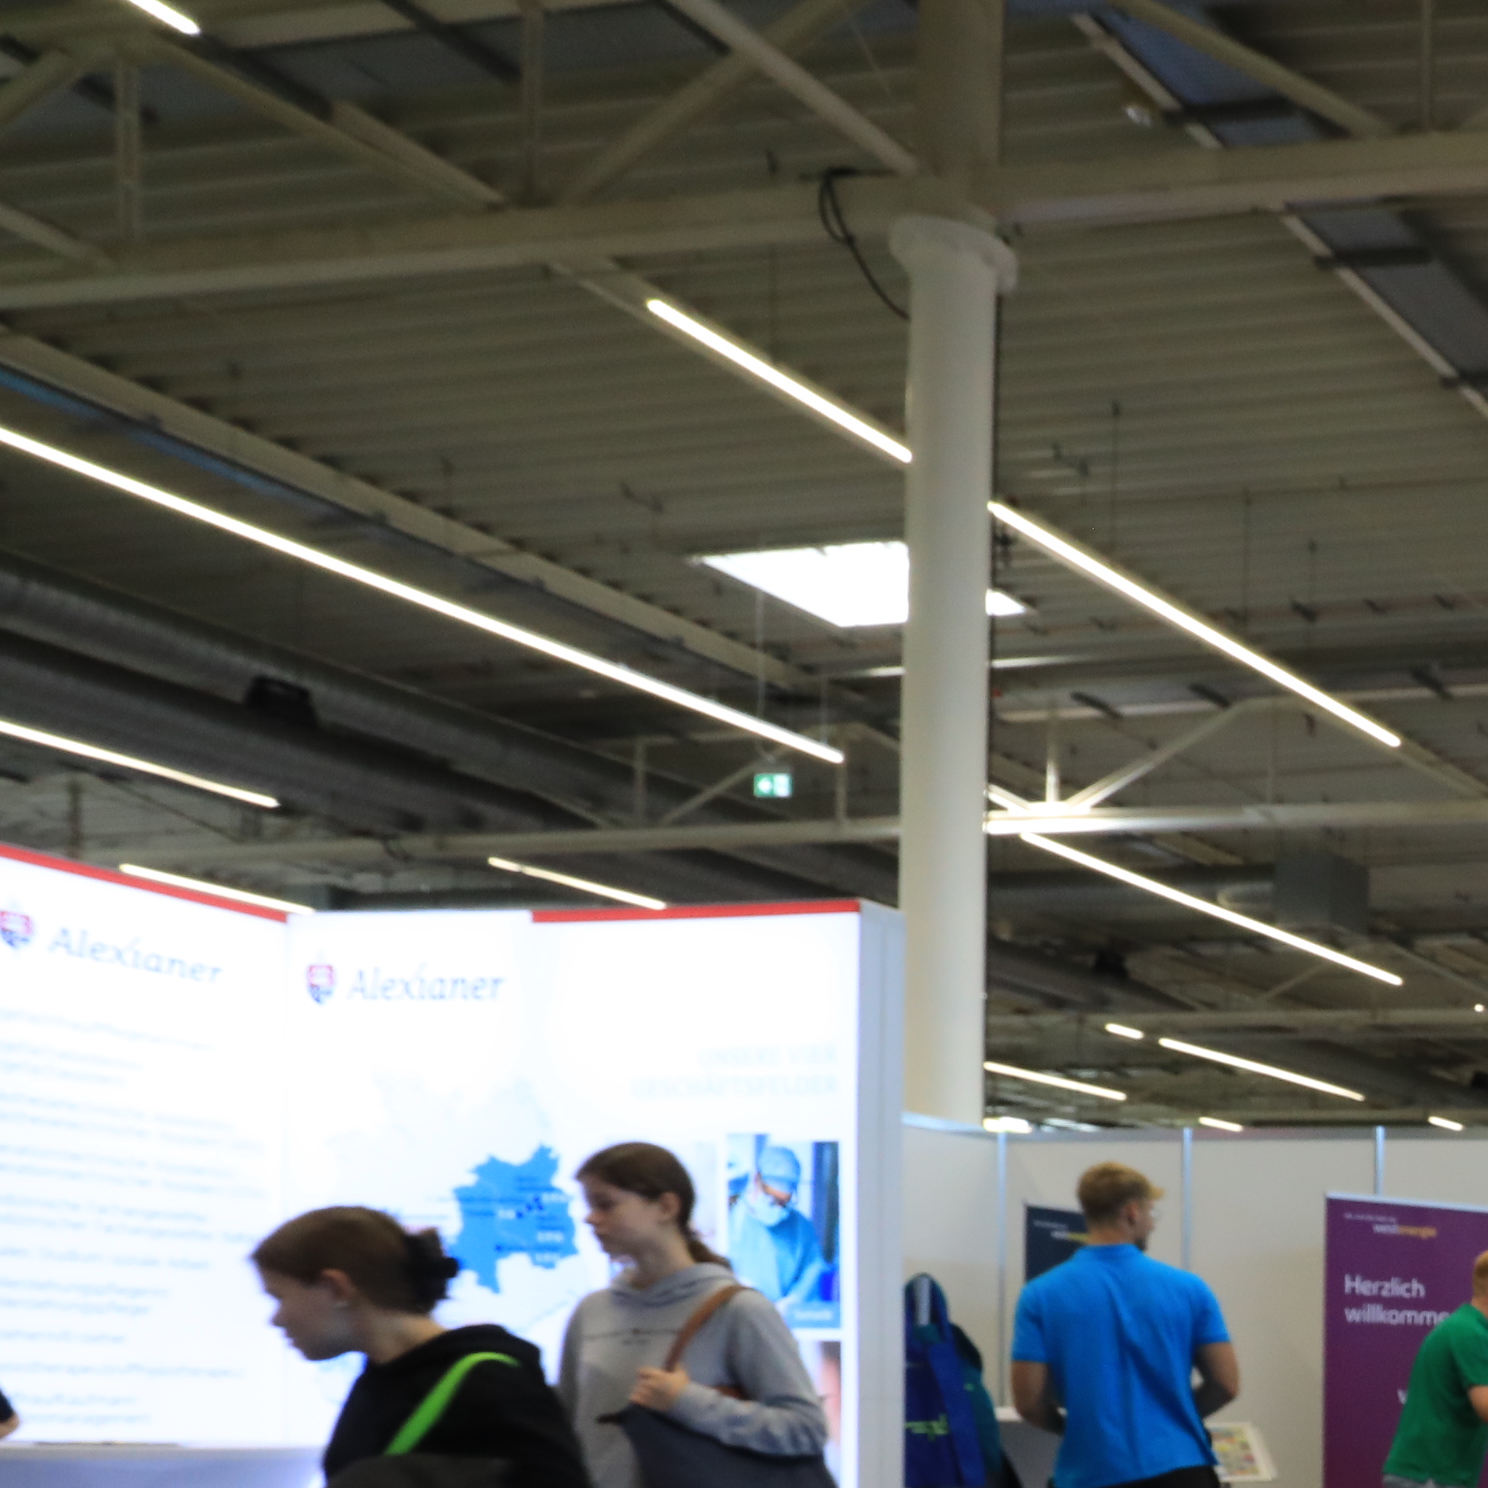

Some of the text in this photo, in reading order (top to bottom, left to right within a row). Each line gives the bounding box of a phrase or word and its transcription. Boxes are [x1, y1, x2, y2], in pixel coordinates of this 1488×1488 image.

[47, 926, 223, 984] Alexianer
[347, 963, 505, 1002] Alexianer
[1344, 1274, 1425, 1298] Herzlich
[1344, 1303, 1451, 1326] willkomme
